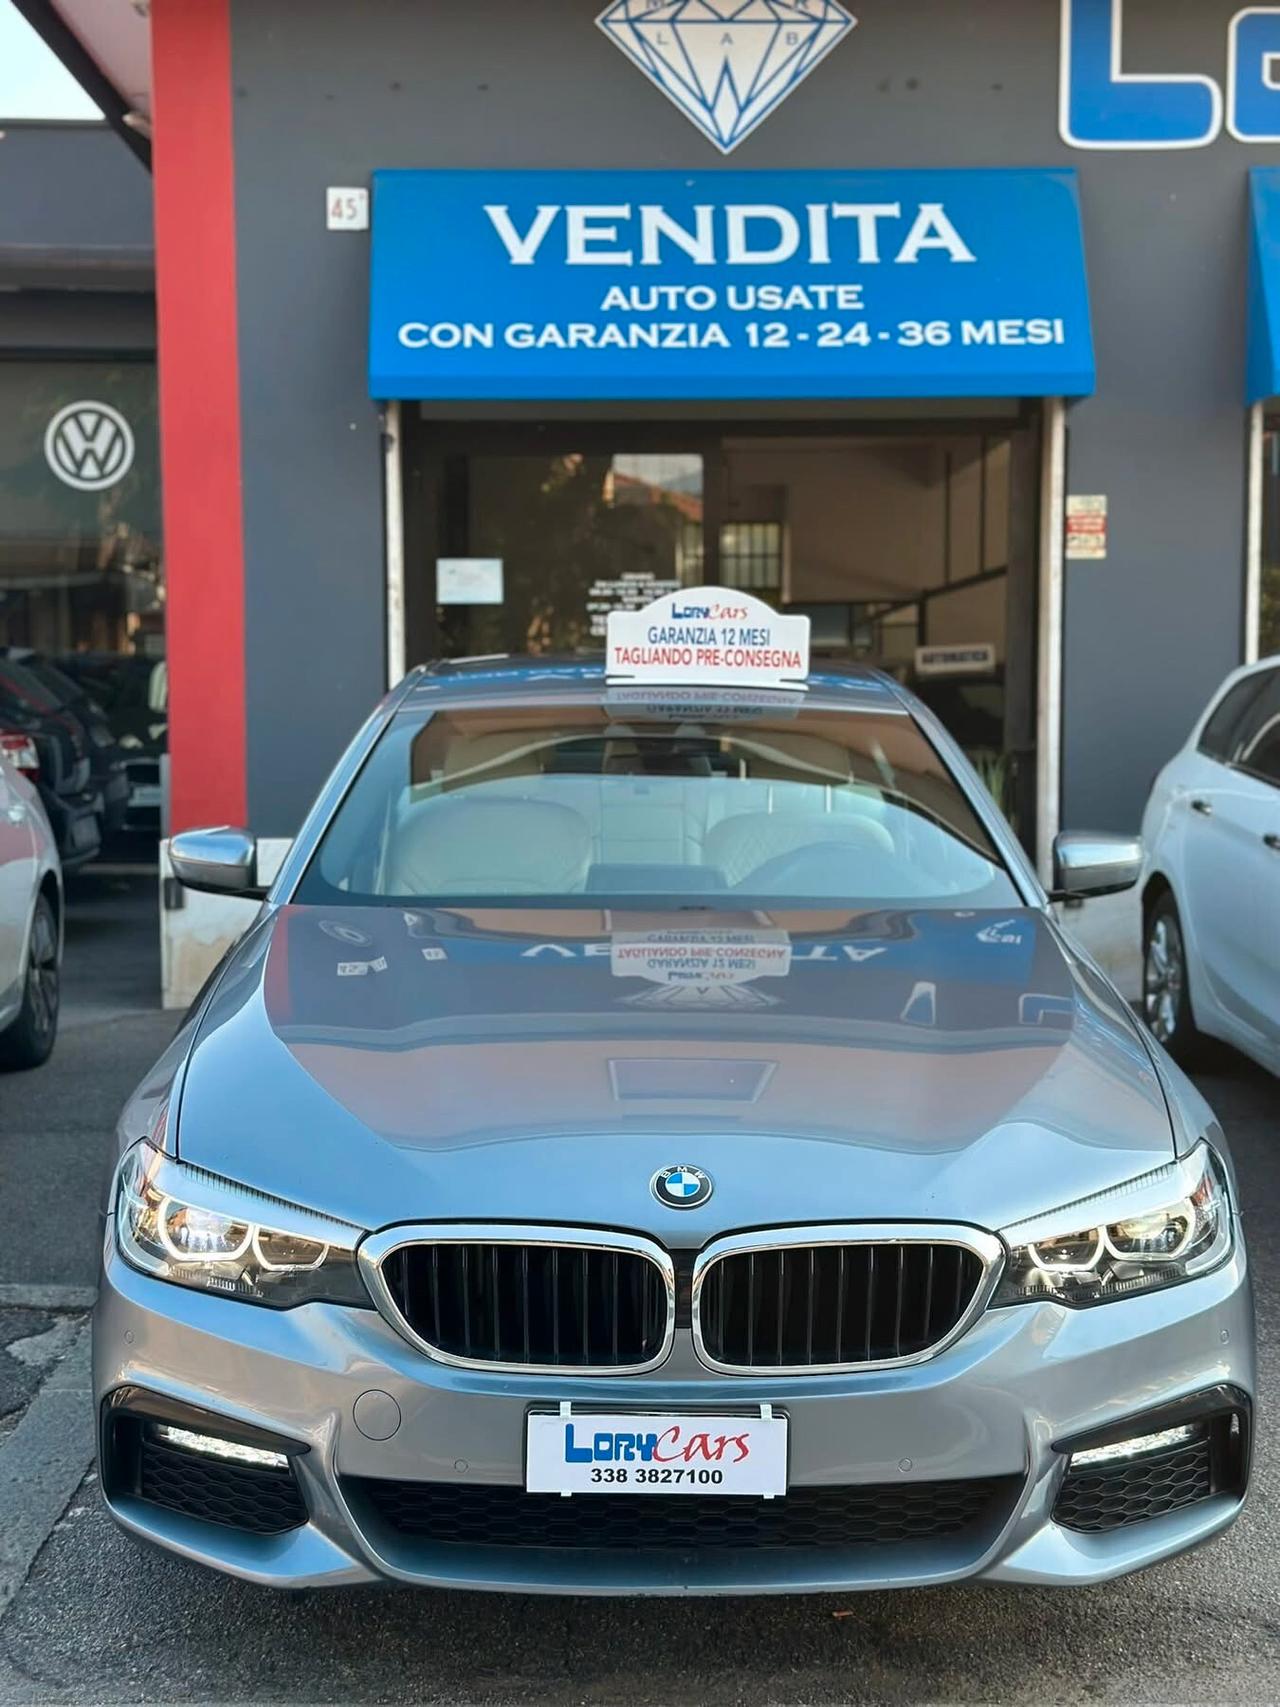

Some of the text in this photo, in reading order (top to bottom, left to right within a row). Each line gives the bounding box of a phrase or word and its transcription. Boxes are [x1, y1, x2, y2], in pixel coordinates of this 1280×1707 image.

[483, 202, 977, 266] VENDITA
[600, 285, 864, 311] AUTO USATE
[397, 322, 494, 348] CON
[504, 322, 731, 348] GARANZIA
[745, 322, 790, 347] 12
[816, 322, 872, 347] 24
[897, 320, 952, 346] 36
[960, 318, 1065, 345] MESI
[647, 626, 771, 647] GARANZIA 12 MESI
[614, 647, 802, 668] TAGLIANDO PRE-CONSEGNA
[661, 1166, 706, 1179] BMW
[590, 1467, 724, 1485] 338 3827100
